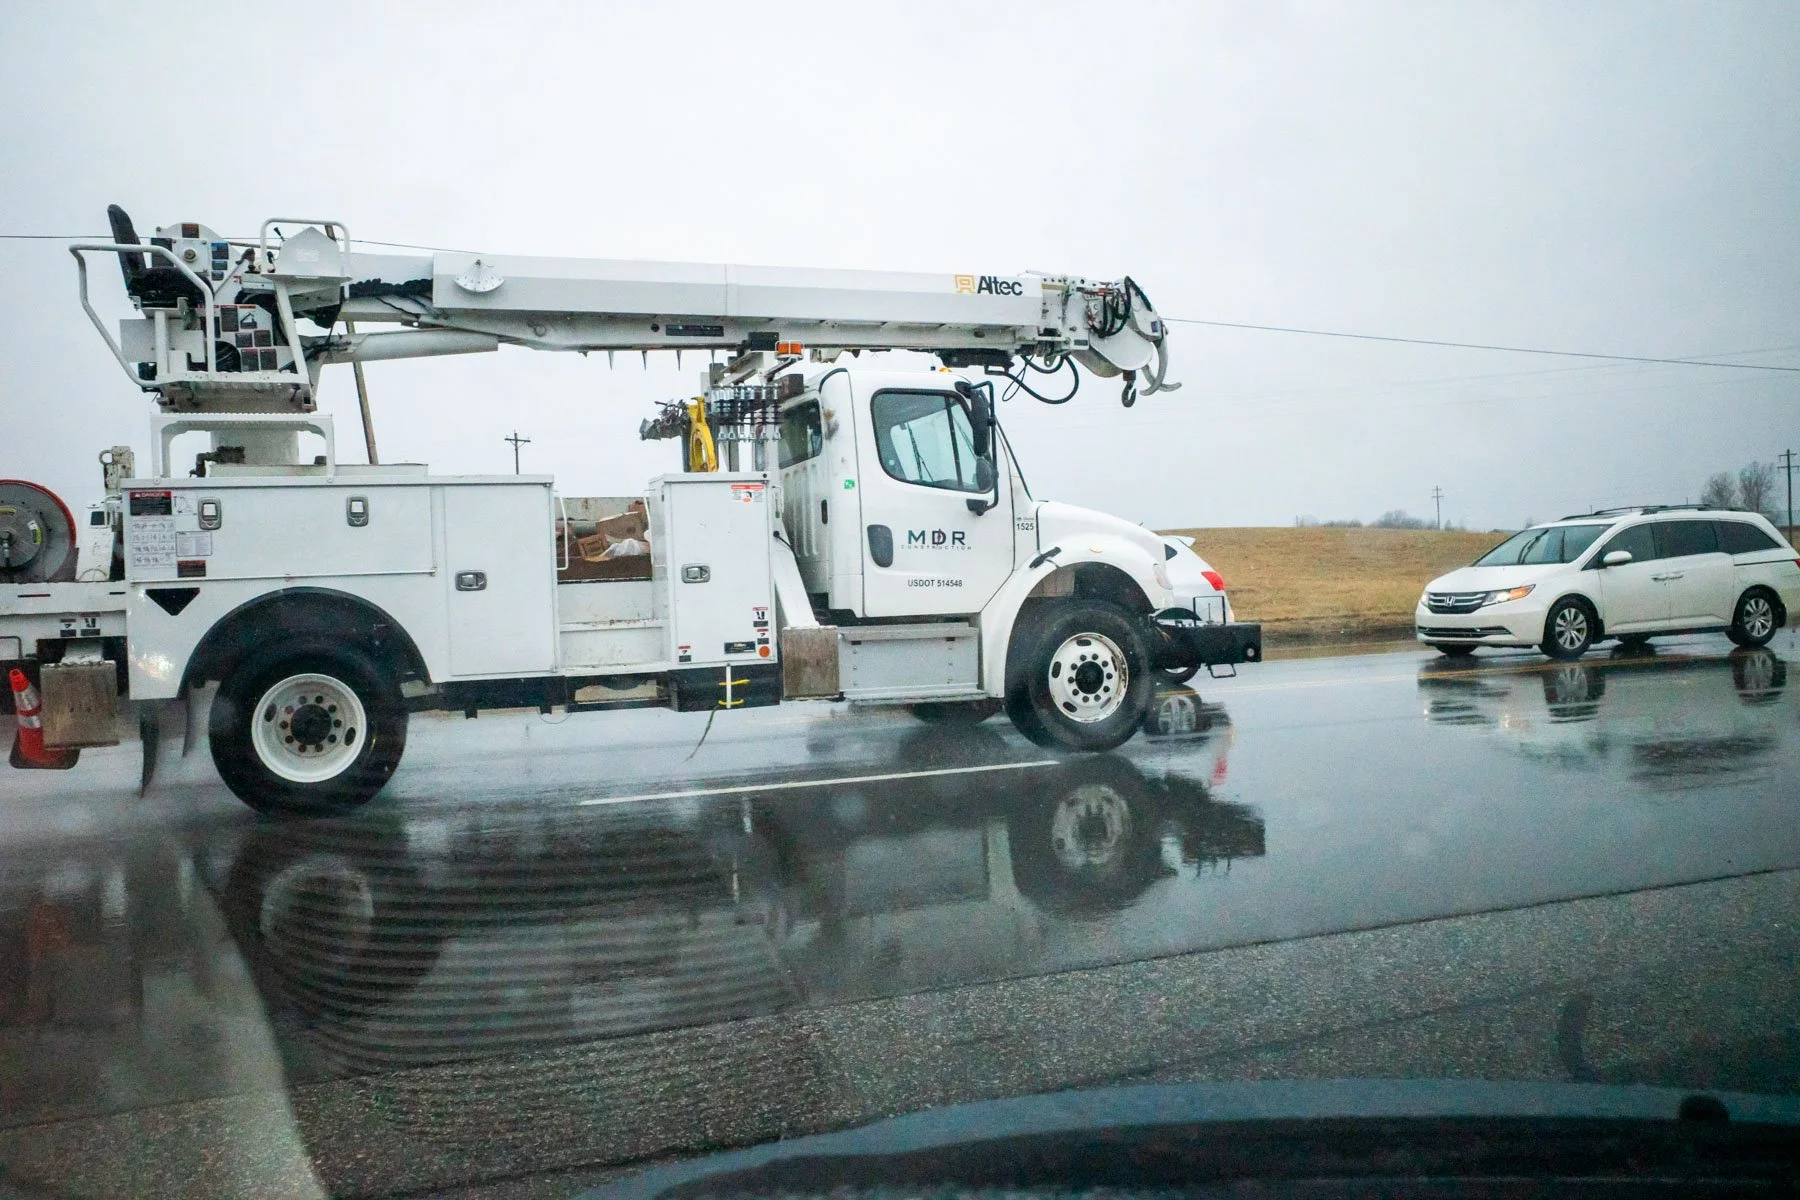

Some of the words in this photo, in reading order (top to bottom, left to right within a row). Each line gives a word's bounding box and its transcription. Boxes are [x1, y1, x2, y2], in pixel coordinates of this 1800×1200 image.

[977, 275, 1023, 296] Altec
[1017, 522, 1034, 531] 1525
[908, 529, 966, 546] MDR
[907, 579, 935, 587] USDOT
[937, 579, 963, 587] 514548
